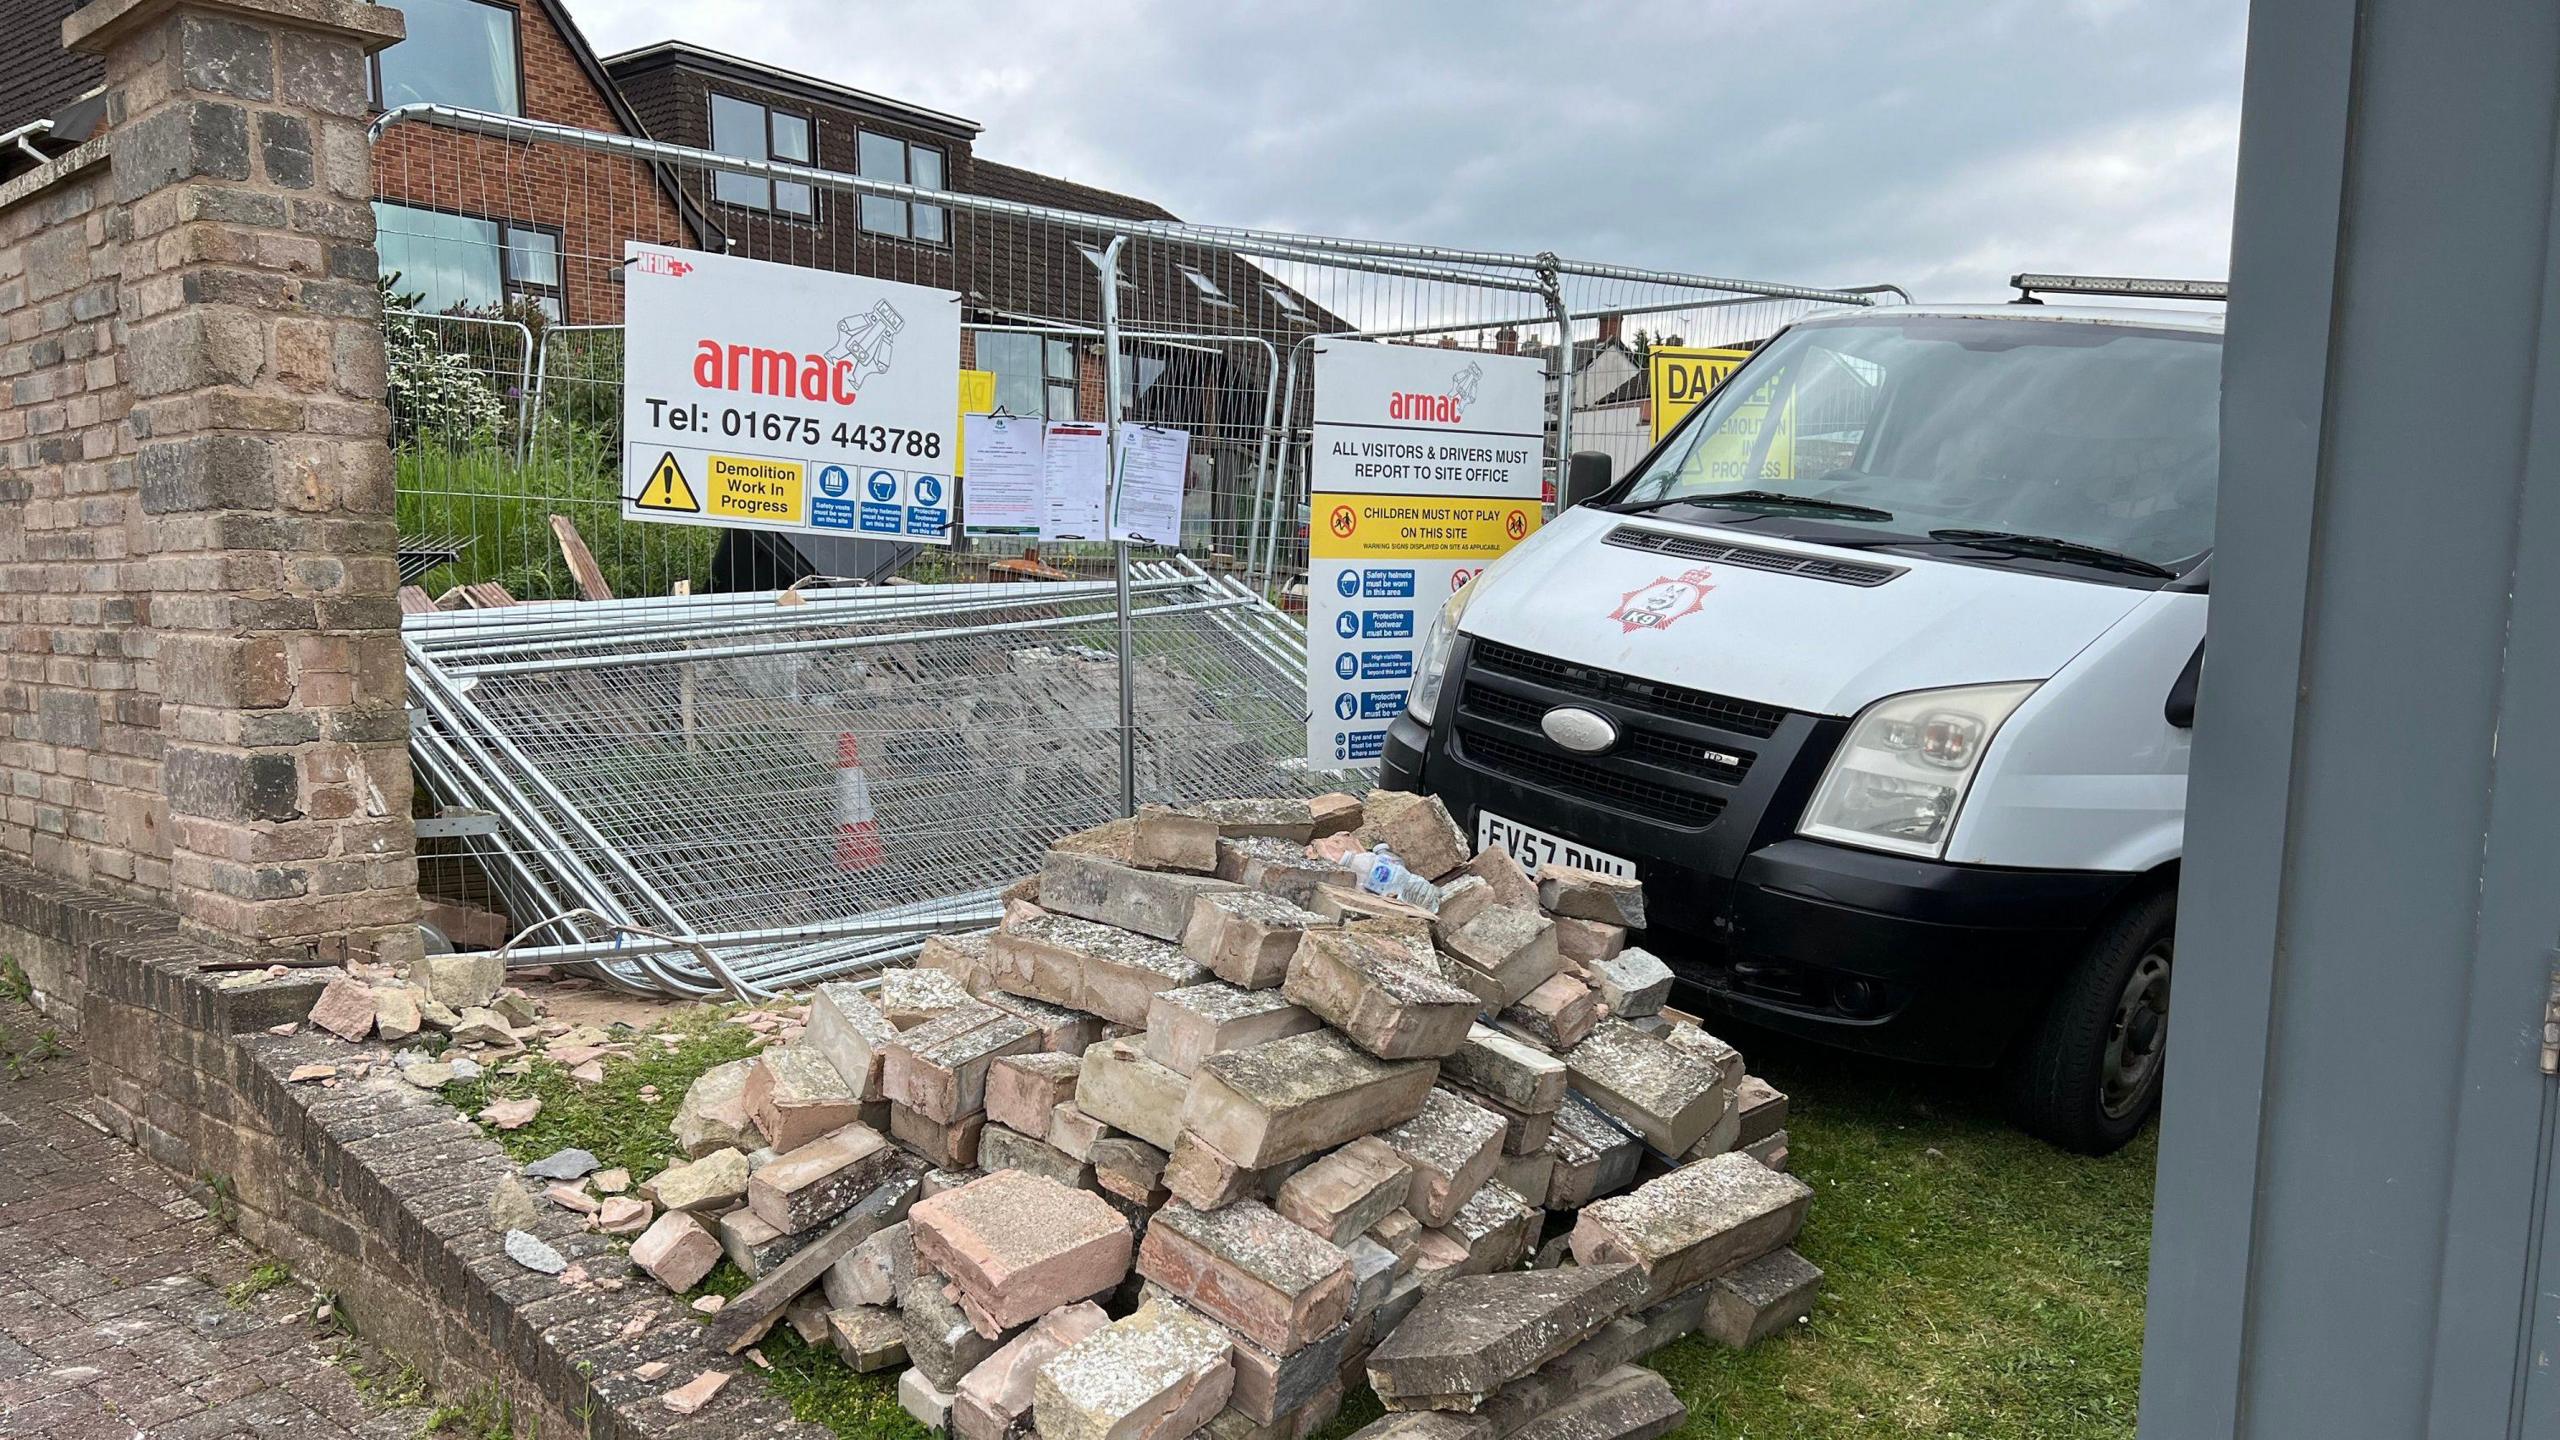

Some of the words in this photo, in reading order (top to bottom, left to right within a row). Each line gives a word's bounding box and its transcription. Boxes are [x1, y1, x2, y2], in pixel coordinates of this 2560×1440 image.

[694, 339, 856, 406] armac
[1390, 391, 1461, 423] armac
[646, 398, 708, 432] Tel:
[722, 408, 820, 445] 01675
[831, 423, 940, 458] 443788
[1713, 417, 1786, 436] EMOLIN
[1333, 442, 1358, 456] ALL
[1362, 443, 1423, 459] VISITORS
[1428, 447, 1435, 460] &
[1440, 447, 1492, 462] DRIVERS
[1496, 450, 1528, 464] MUST
[716, 461, 795, 480] Demolition
[1355, 464, 1410, 478] REPORT
[1415, 466, 1430, 479] TO
[1435, 467, 1461, 481] SITE
[1466, 468, 1508, 482] OFFICE
[1711, 462, 1781, 478] PROSS
[728, 479, 765, 494] Work
[772, 483, 783, 496] In
[722, 495, 787, 513] Progress
[1365, 508, 1418, 519] CHILDREN
[1422, 509, 1450, 519] MUST
[1454, 510, 1473, 520] NOT
[1477, 511, 1500, 520] PLAY
[1401, 527, 1416, 537] ON
[1421, 528, 1442, 538] THIS
[1446, 528, 1467, 538] SITE
[1367, 571, 1386, 579] Safety
[1625, 610, 1657, 625] K9
[1375, 701, 1396, 710] gloves
